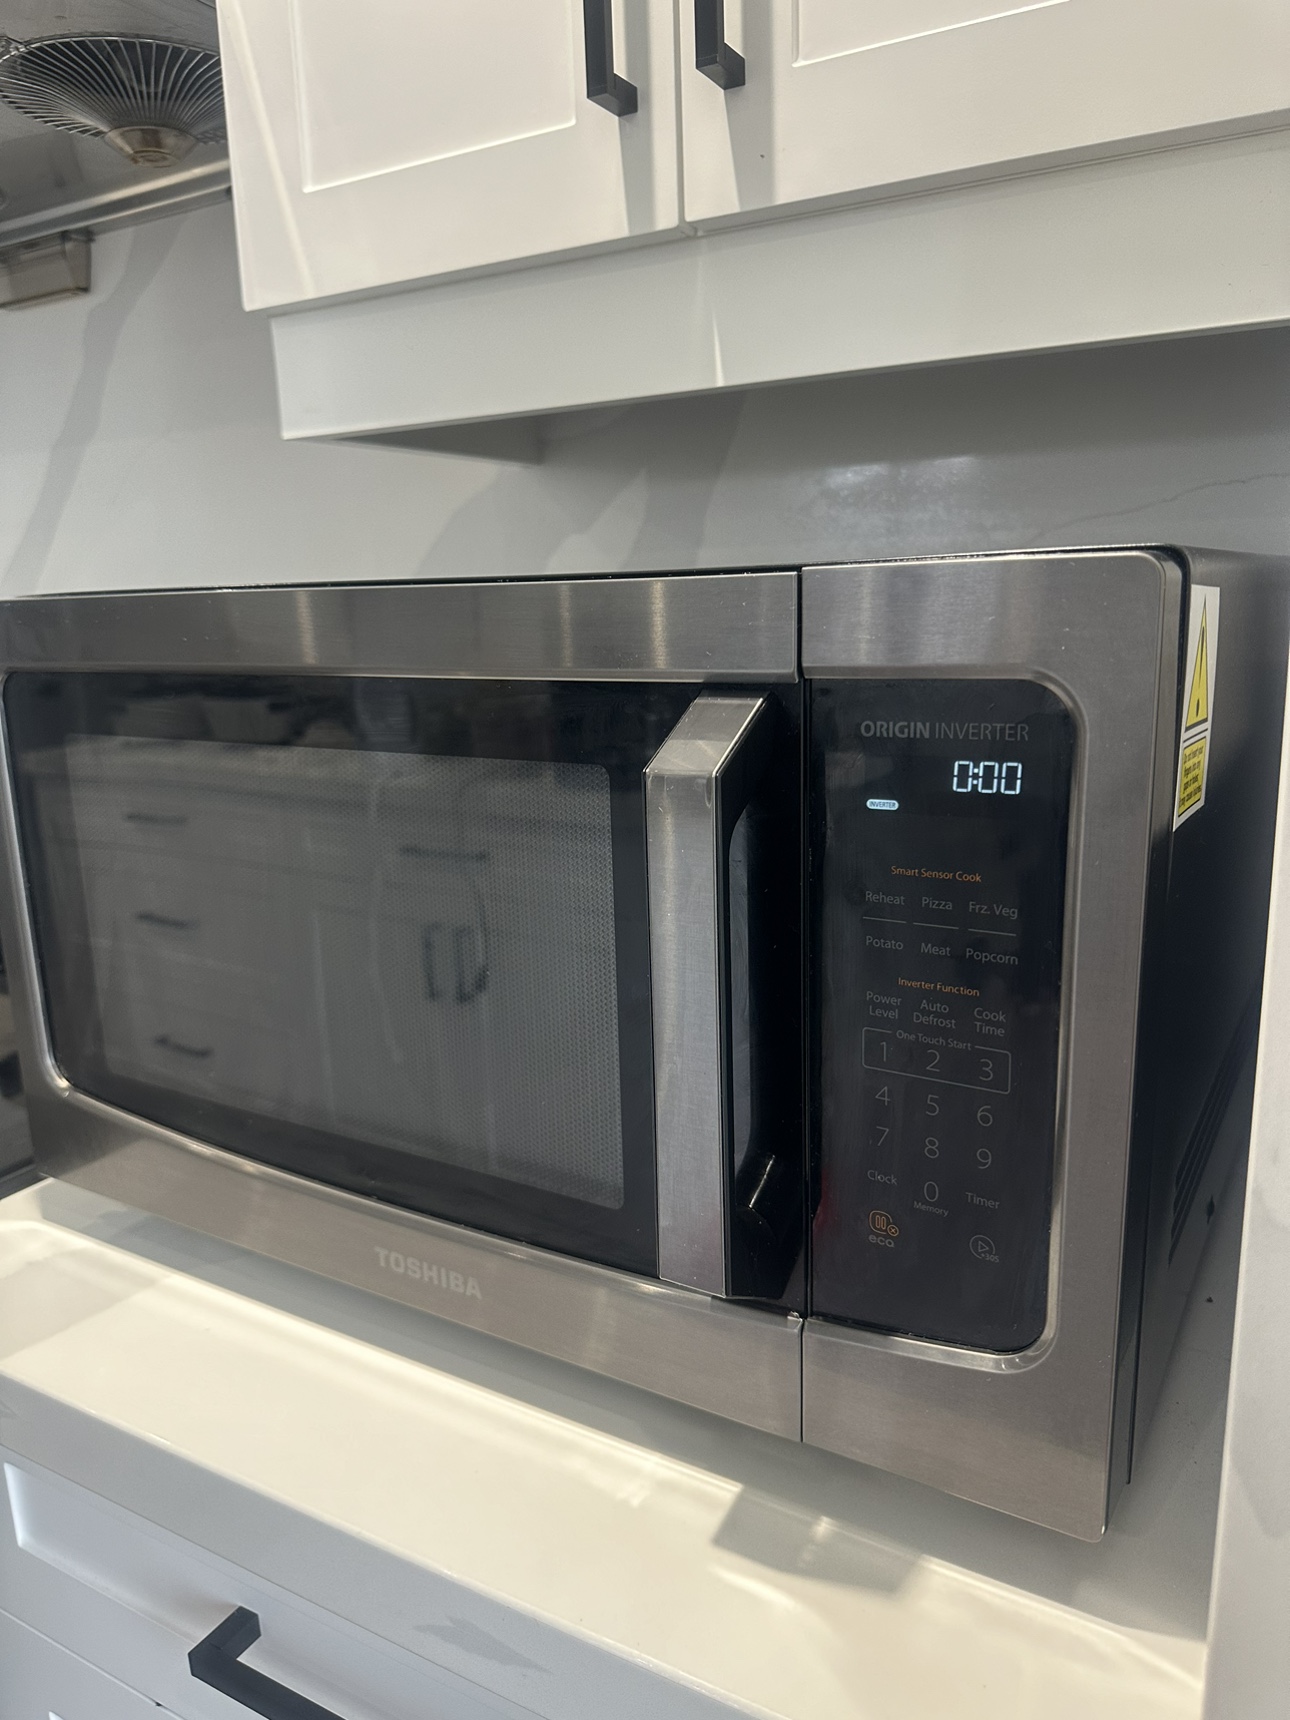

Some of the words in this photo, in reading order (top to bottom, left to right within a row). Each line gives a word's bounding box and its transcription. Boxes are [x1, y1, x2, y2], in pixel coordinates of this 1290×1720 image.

[860, 721, 930, 739] ORIGIN
[935, 722, 1029, 741] INVERTER
[952, 760, 1023, 795] 0:00
[869, 800, 897, 809] INVERTER
[891, 865, 918, 876] Smart
[921, 868, 954, 880] Sensor
[955, 871, 982, 883] Cook
[865, 891, 905, 905] Reheat
[921, 896, 953, 910] Pizza
[968, 901, 991, 914] Frz.
[993, 904, 1018, 919] Veg
[865, 935, 904, 950] Potato
[920, 942, 951, 956] Meat
[965, 948, 1019, 965] Popcorn
[898, 977, 934, 990] Inverter
[936, 982, 980, 997] Function
[866, 991, 902, 1006] Power
[920, 1000, 949, 1013] Auto
[869, 1005, 899, 1019] Level
[913, 1012, 956, 1029] Defrost
[973, 1007, 1006, 1022] Cook
[974, 1022, 1005, 1037] Time
[896, 1030, 917, 1041] One
[918, 1033, 946, 1046] Touch
[947, 1038, 972, 1051] Start
[880, 1041, 887, 1062] 1
[926, 1049, 941, 1072] 2
[978, 1058, 994, 1081] 3
[875, 1086, 891, 1106] 4
[926, 1094, 940, 1116] 5
[976, 1105, 993, 1127] 6
[875, 1125, 889, 1147] 7
[924, 1137, 939, 1159] 8
[976, 1148, 992, 1169] 9
[867, 1169, 898, 1186] Clock
[923, 1181, 939, 1202] 0
[965, 1191, 1001, 1210] Timer
[913, 1200, 949, 1217] Memory
[374, 1246, 482, 1300] TOSHIBA
